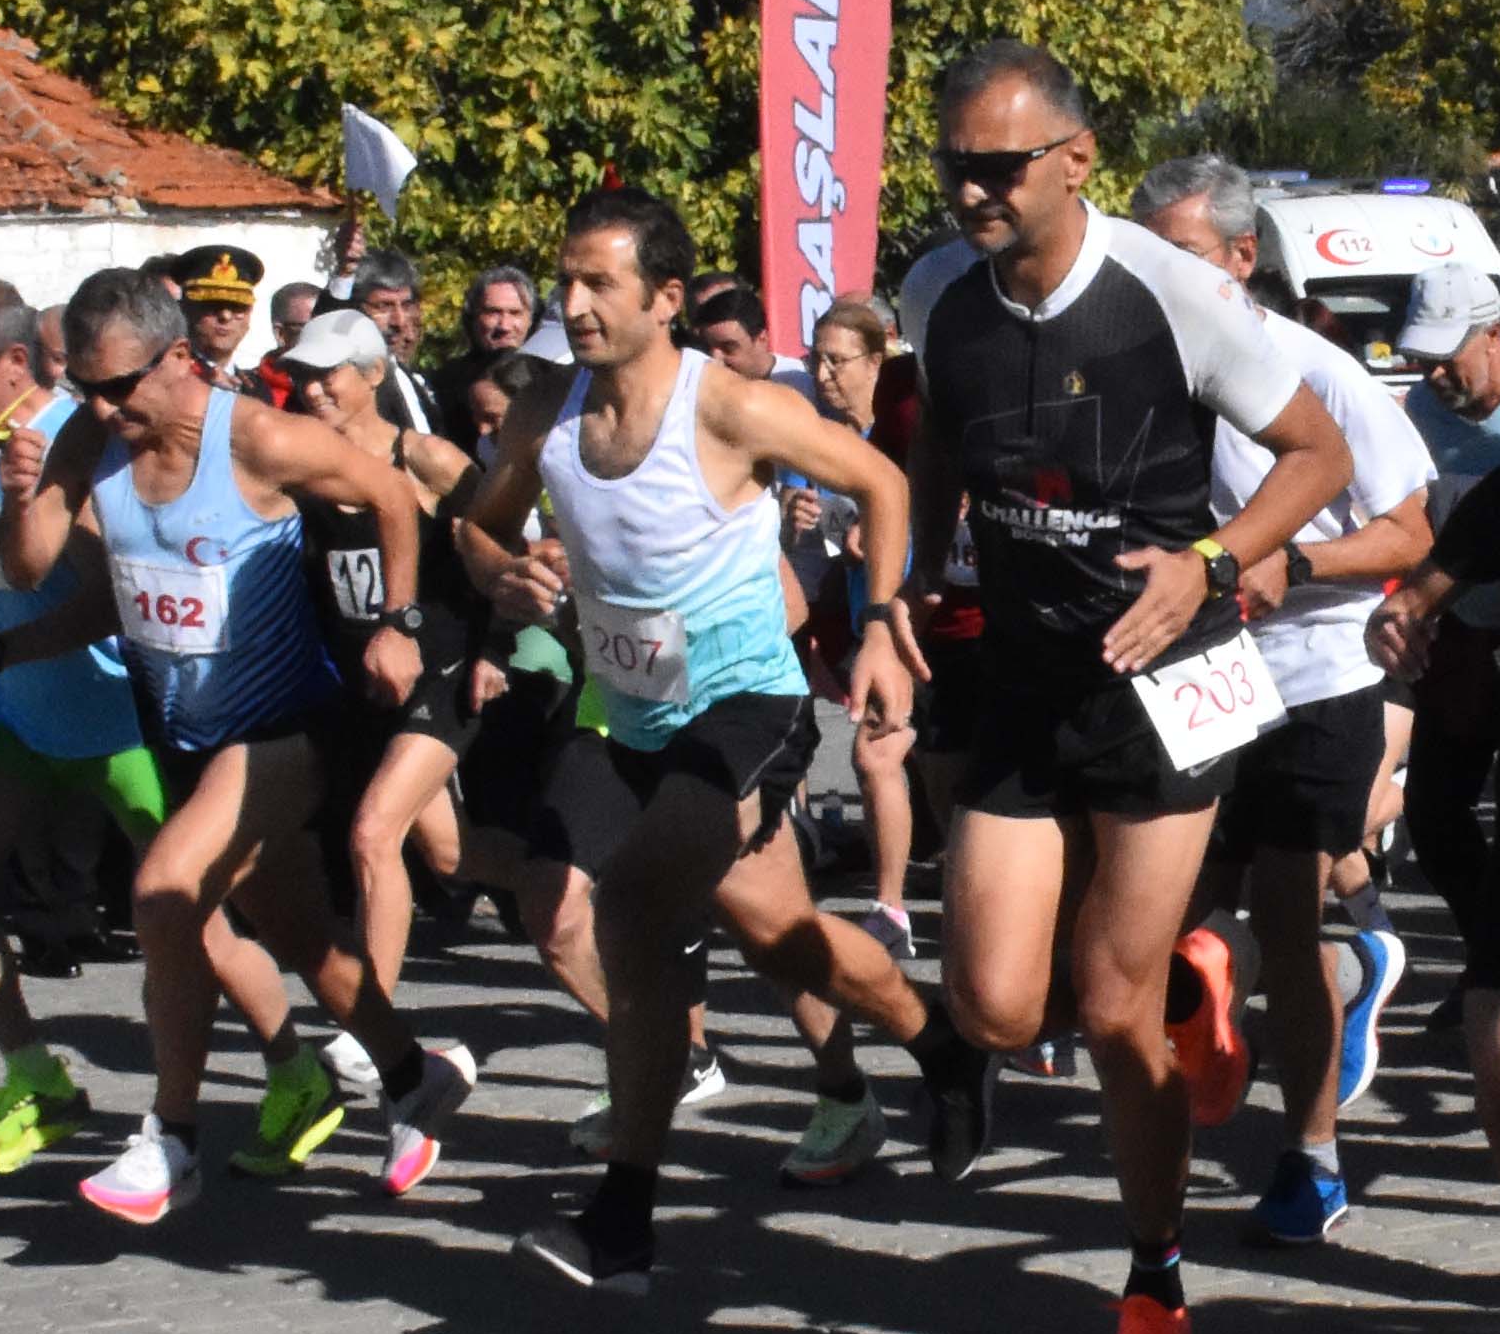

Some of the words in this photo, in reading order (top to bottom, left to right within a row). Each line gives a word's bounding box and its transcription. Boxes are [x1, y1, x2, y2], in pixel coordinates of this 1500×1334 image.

[1339, 236, 1373, 253] 112
[134, 590, 205, 628] 162
[1174, 661, 1255, 730] 203
